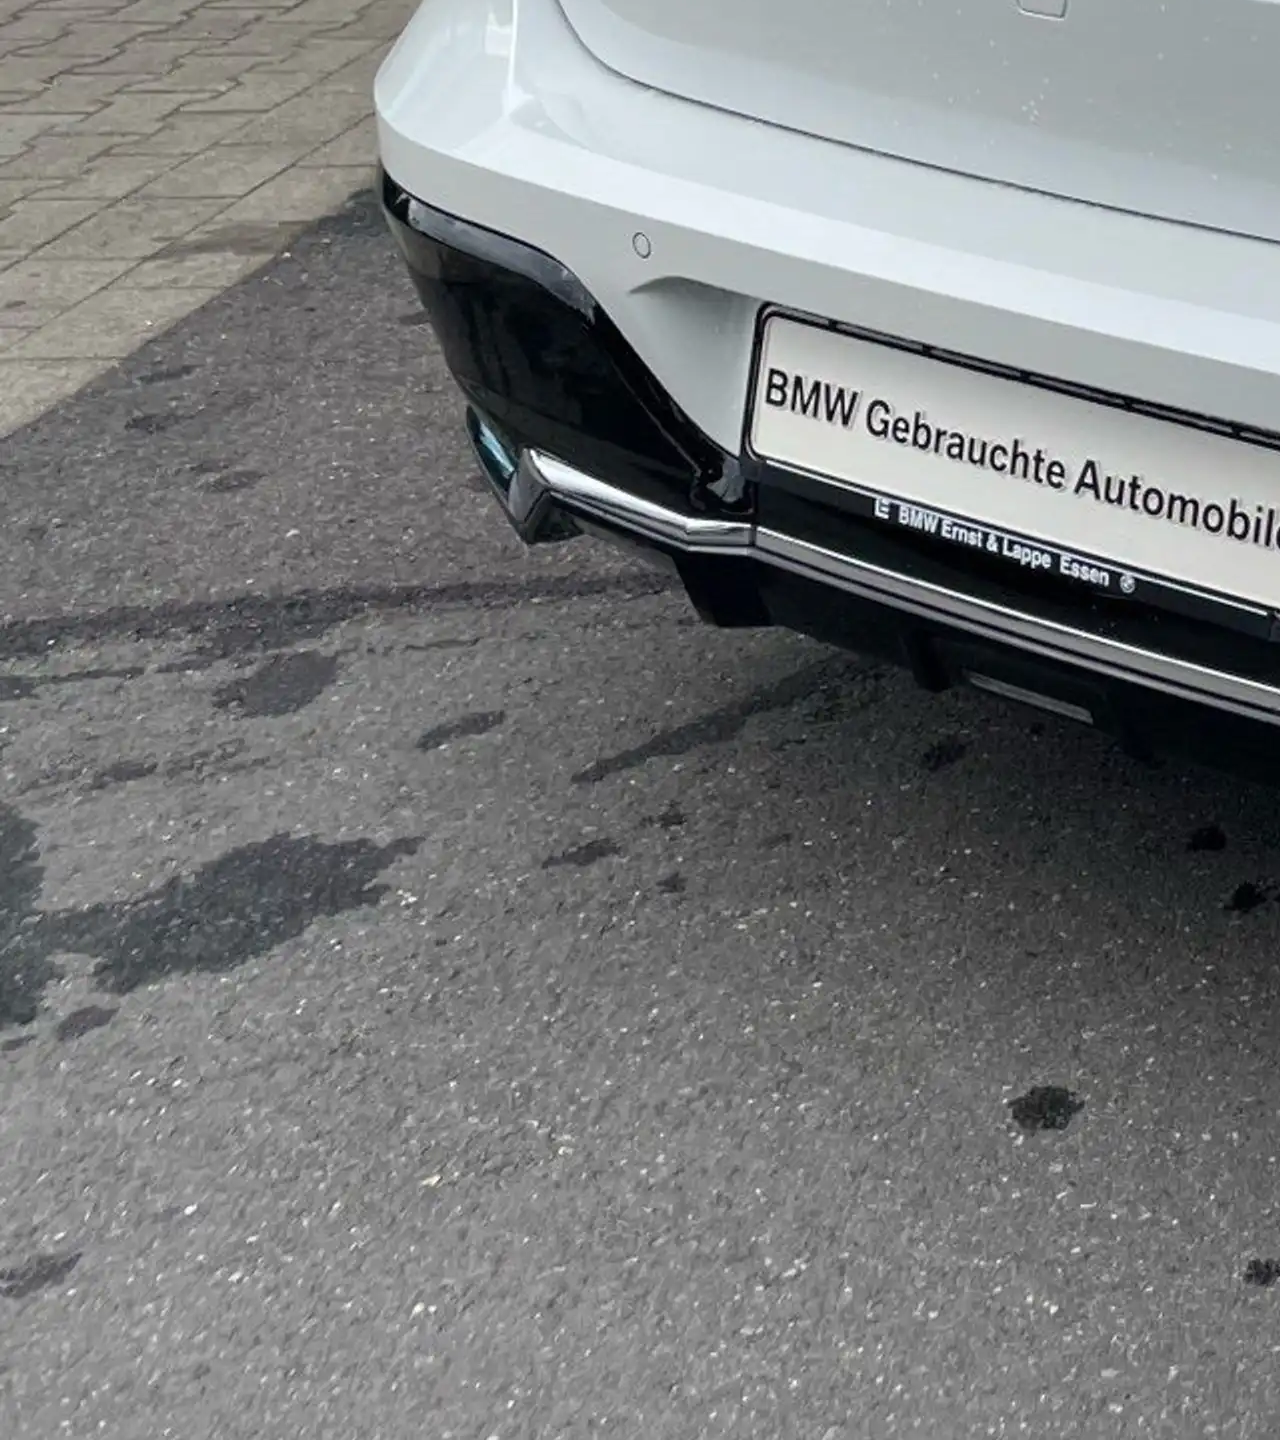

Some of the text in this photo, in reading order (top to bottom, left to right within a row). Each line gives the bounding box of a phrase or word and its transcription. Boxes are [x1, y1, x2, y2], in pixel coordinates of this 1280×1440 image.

[764, 367, 858, 428] BMW
[865, 399, 1066, 491] Gebrauchte
[899, 506, 939, 533] BMW
[941, 518, 984, 548] Ernst
[986, 533, 998, 552] &
[1002, 537, 1052, 570] Lappe
[1059, 556, 1110, 588] Essen
